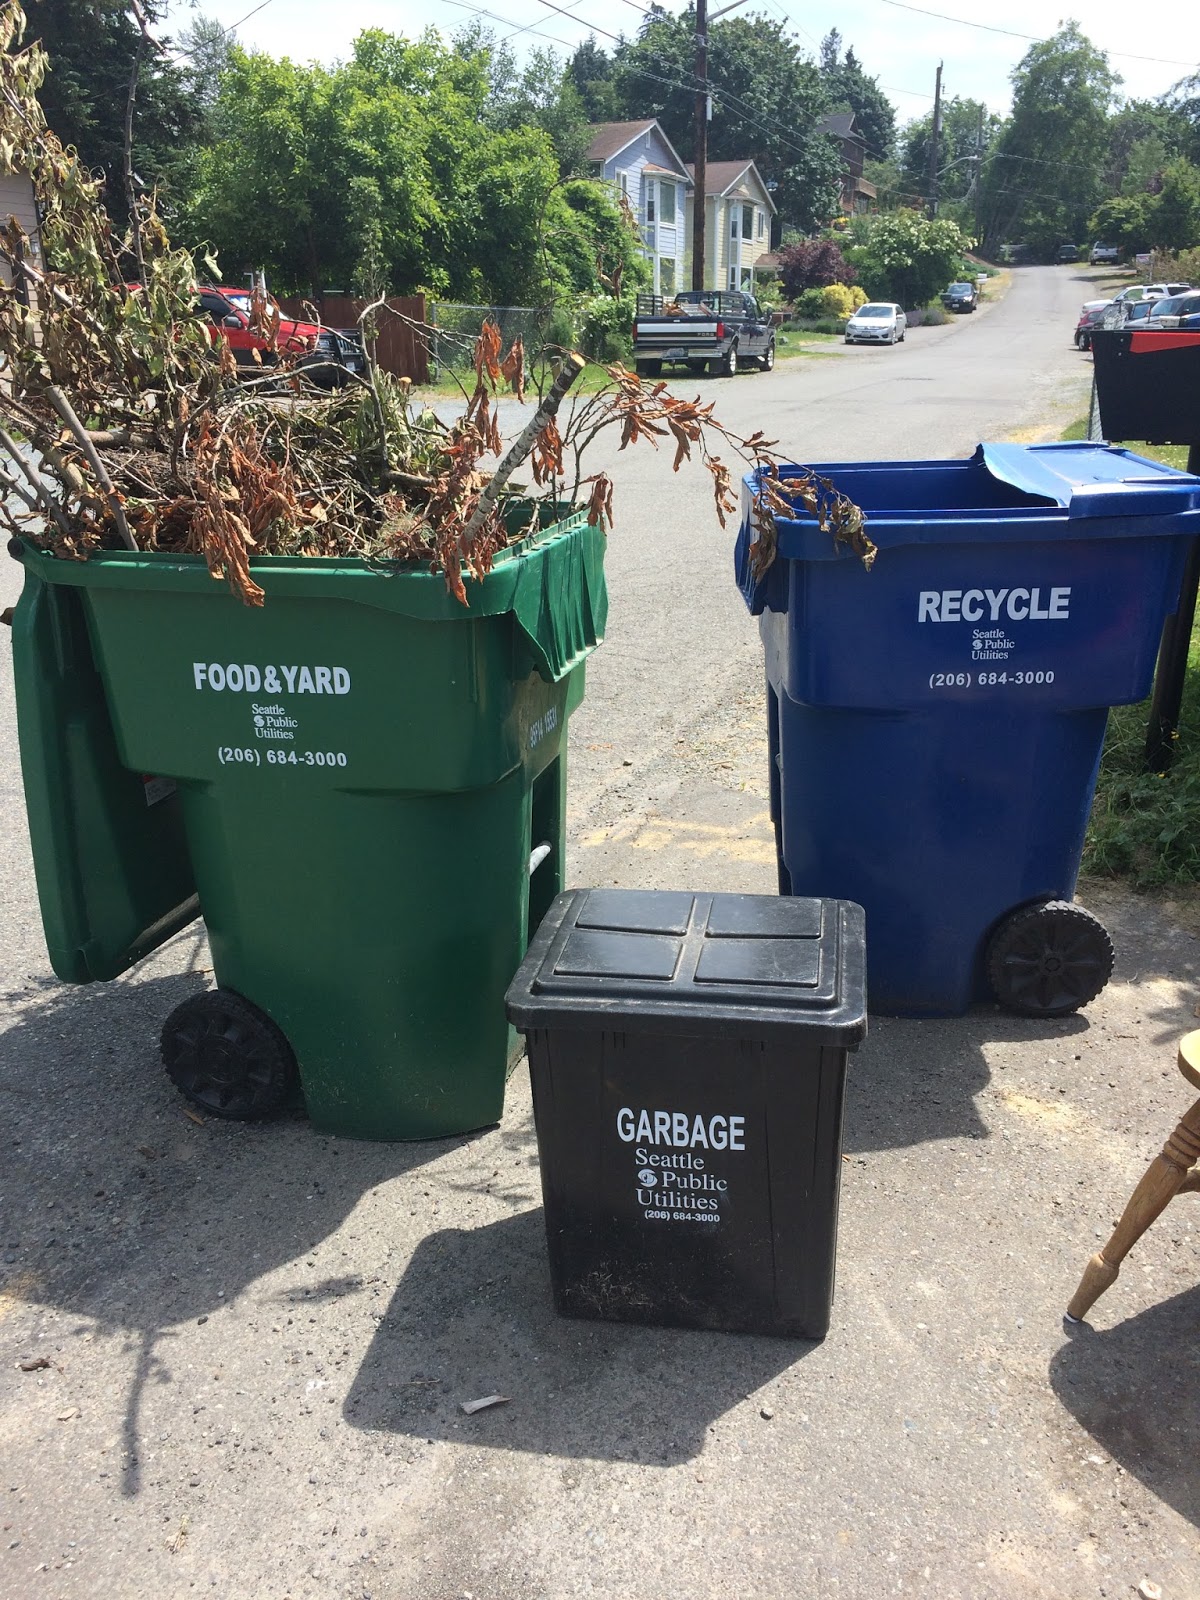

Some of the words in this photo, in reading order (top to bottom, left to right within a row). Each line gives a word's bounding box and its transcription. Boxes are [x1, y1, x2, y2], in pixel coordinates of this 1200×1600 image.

[918, 587, 1071, 622] RECYCLE
[972, 629, 1005, 639] Seattle
[985, 639, 1015, 649] Public
[971, 650, 1009, 660] Utilities
[193, 663, 350, 694] FOOD&YARD
[930, 673, 971, 688] (206)
[978, 671, 1054, 685] 684-3000
[251, 703, 286, 715] Seattle
[266, 716, 298, 728] Public
[254, 728, 294, 739] Utilities
[219, 747, 260, 766] (206)
[267, 750, 346, 766] 684-3000
[617, 1107, 746, 1151] GARBAGE
[635, 1148, 705, 1170] Seattle
[662, 1171, 728, 1191] Public
[636, 1188, 718, 1210] Utilities
[645, 1210, 670, 1221] (206)
[673, 1212, 720, 1222] 684-3000
